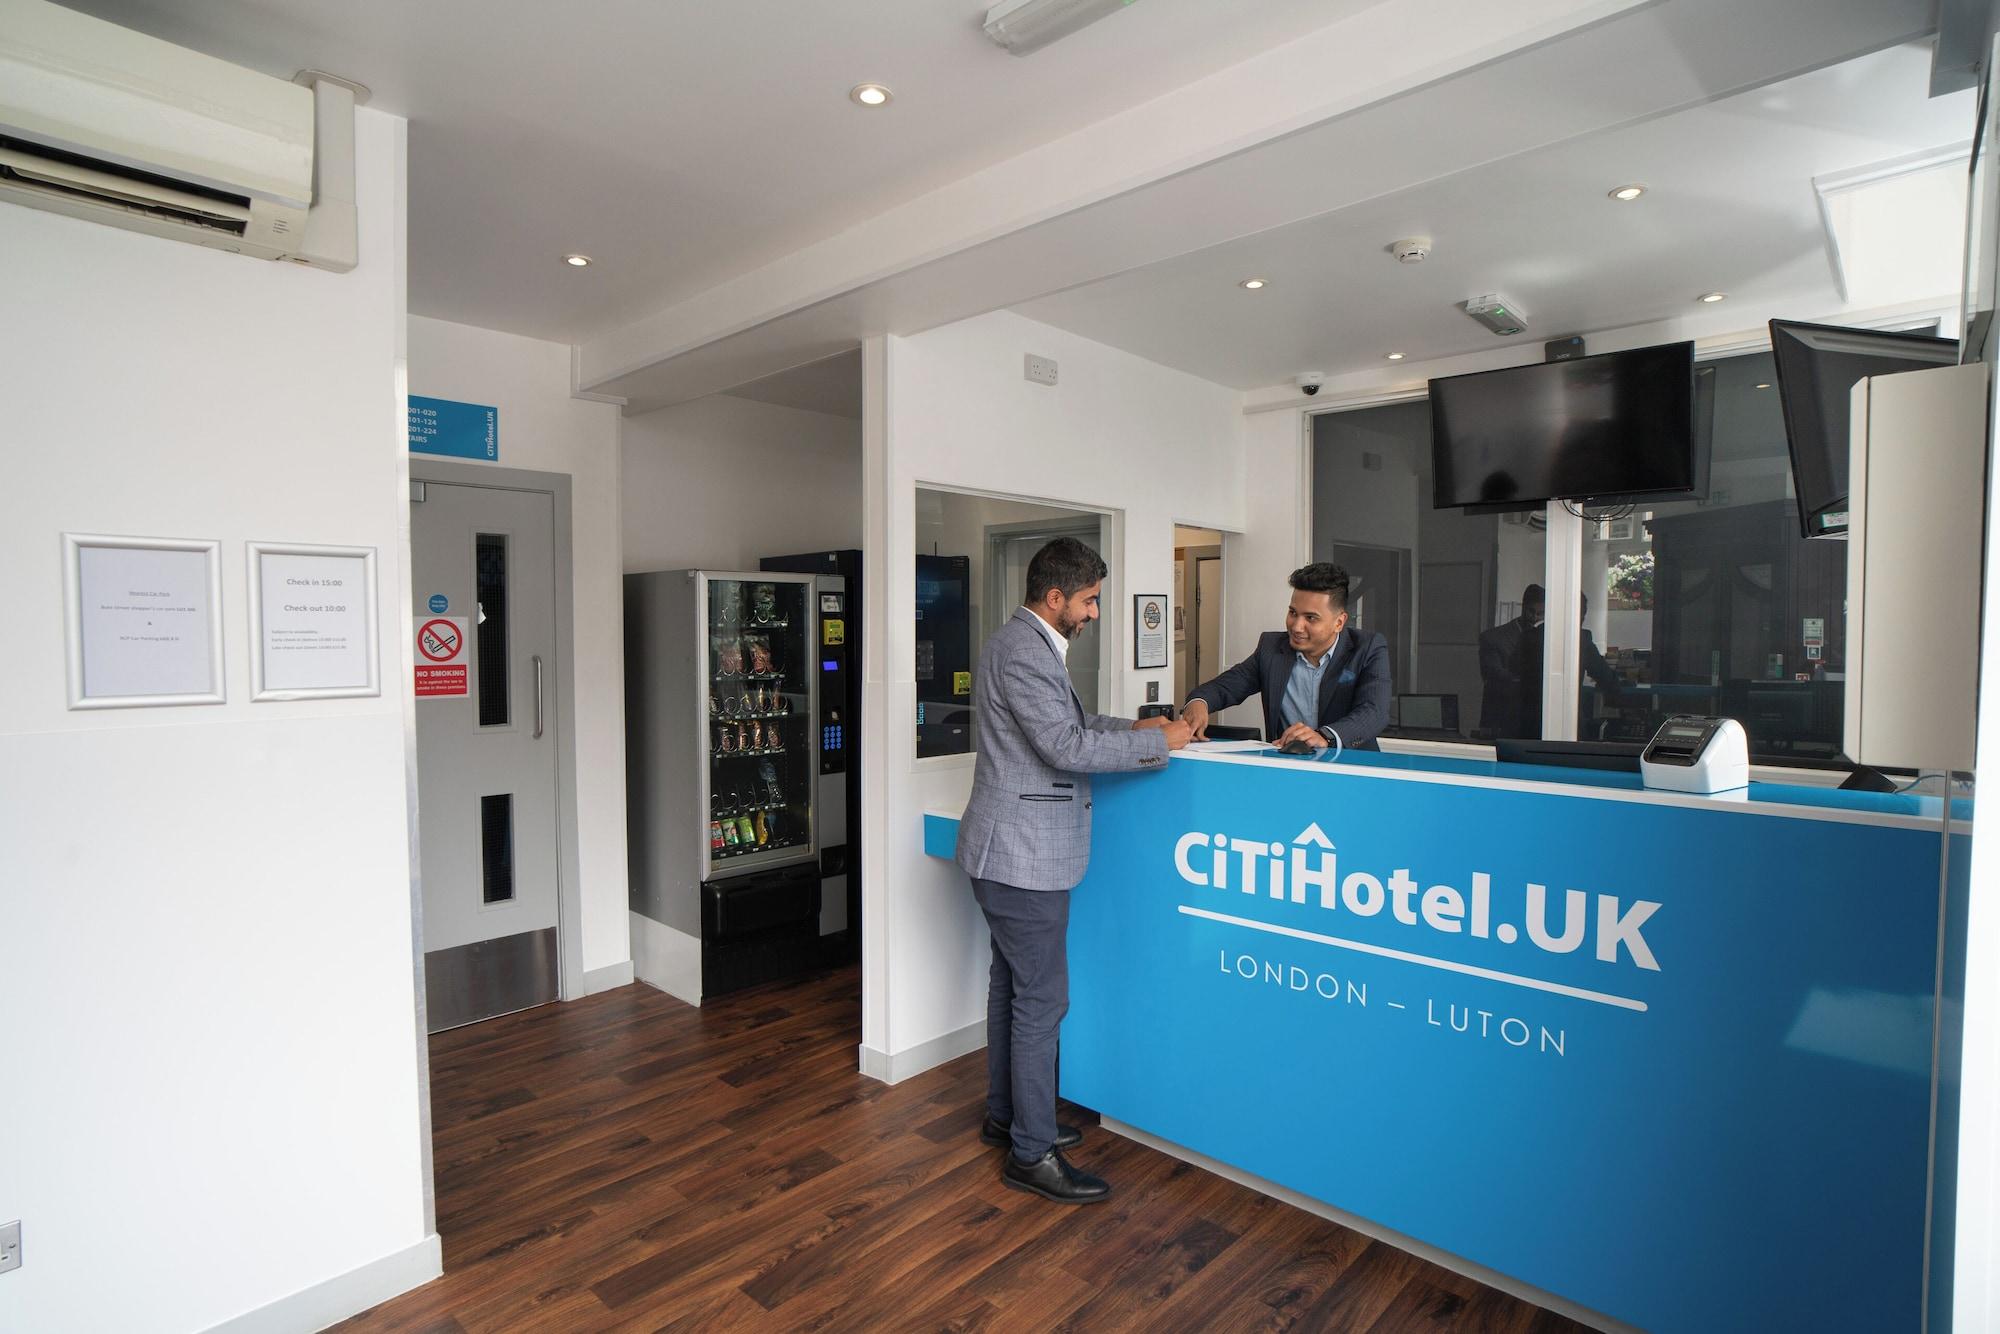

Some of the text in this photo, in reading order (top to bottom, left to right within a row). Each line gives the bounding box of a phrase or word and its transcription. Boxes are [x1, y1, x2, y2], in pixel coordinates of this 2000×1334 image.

[284, 604, 308, 612] Check
[325, 605, 346, 613] 10:00
[286, 578, 310, 586] Check
[321, 579, 343, 587] 15:00
[1174, 822, 1663, 972] CiTiHotel.UK
[1220, 950, 1367, 1007] LONDON
[1427, 999, 1565, 1056] LUTON
